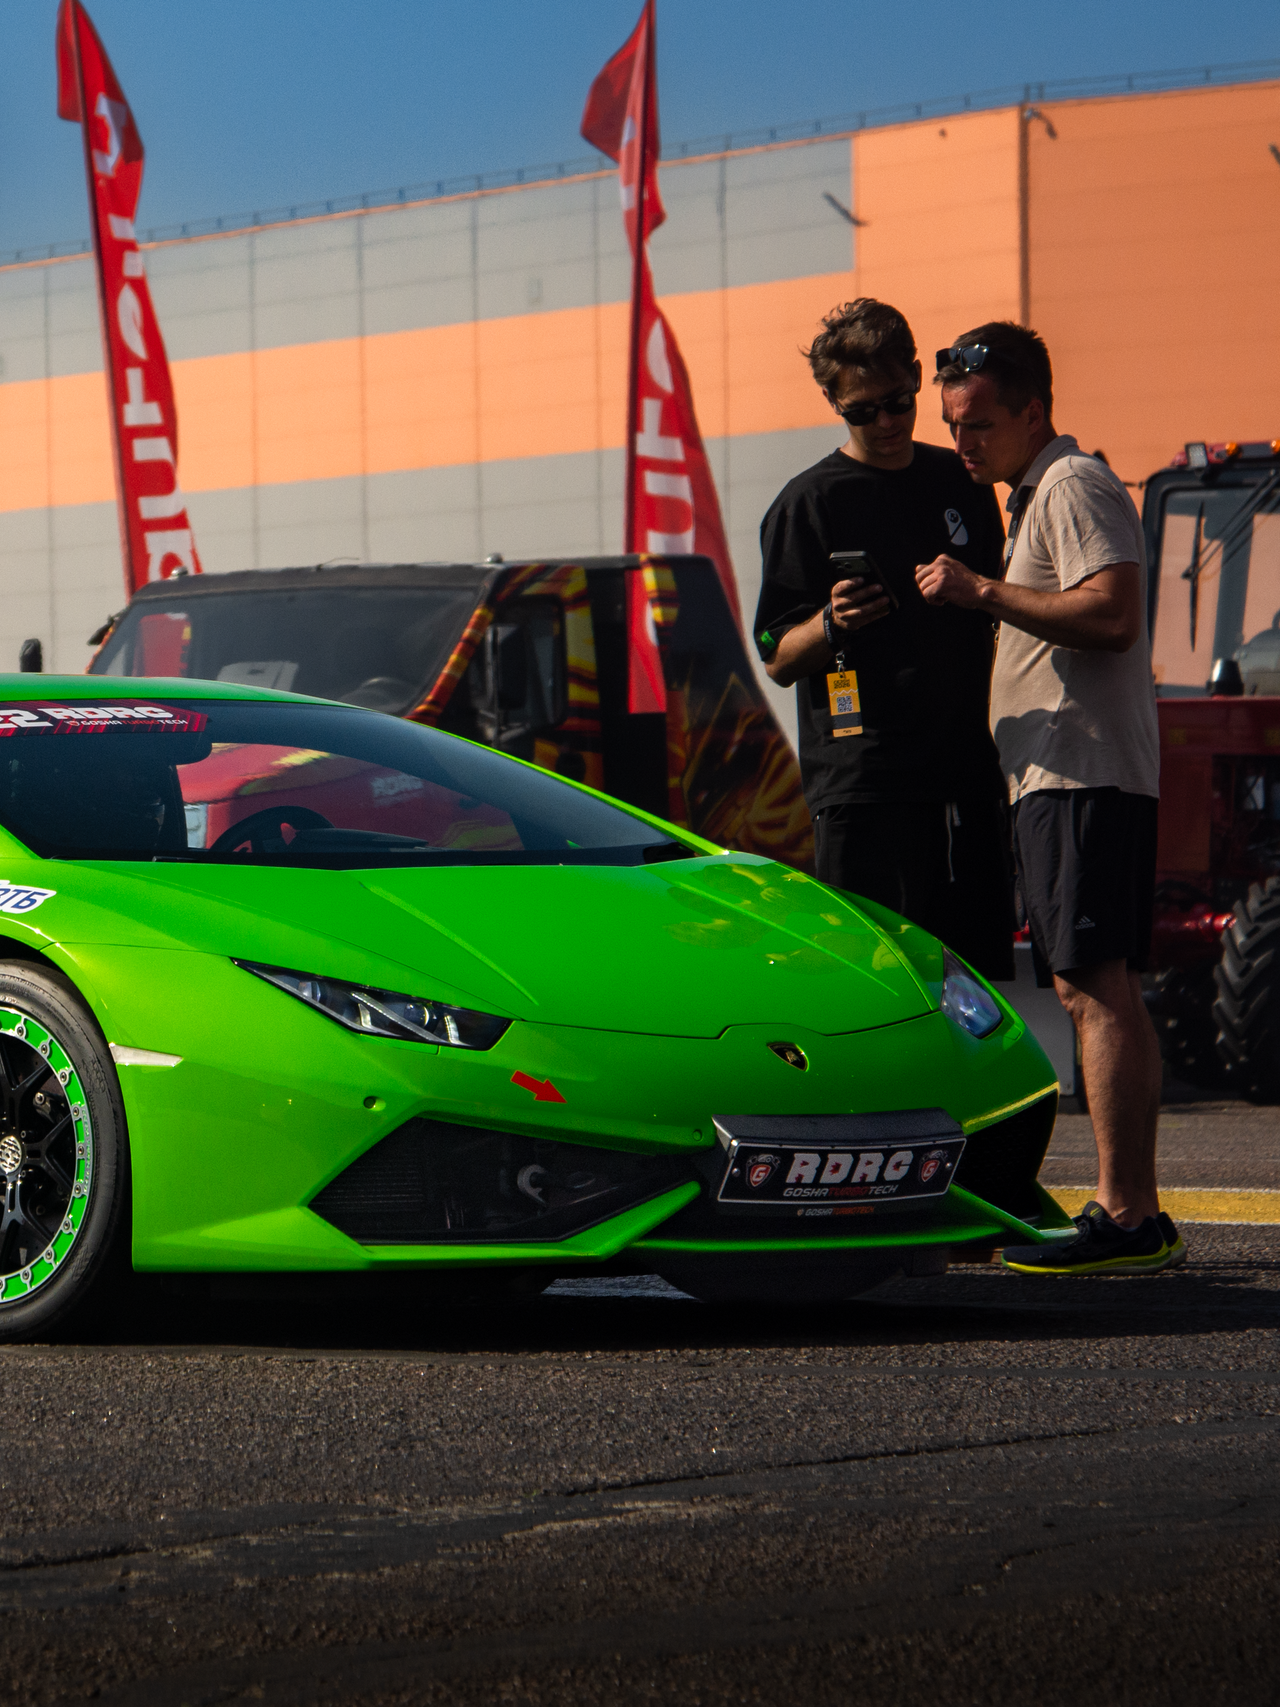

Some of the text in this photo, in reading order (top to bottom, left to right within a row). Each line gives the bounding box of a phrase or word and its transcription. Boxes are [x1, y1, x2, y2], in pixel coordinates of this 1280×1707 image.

[38, 707, 174, 720] RDRC
[785, 1150, 914, 1184] RDRC
[783, 1184, 899, 1197] GOSHATURBOTECH
